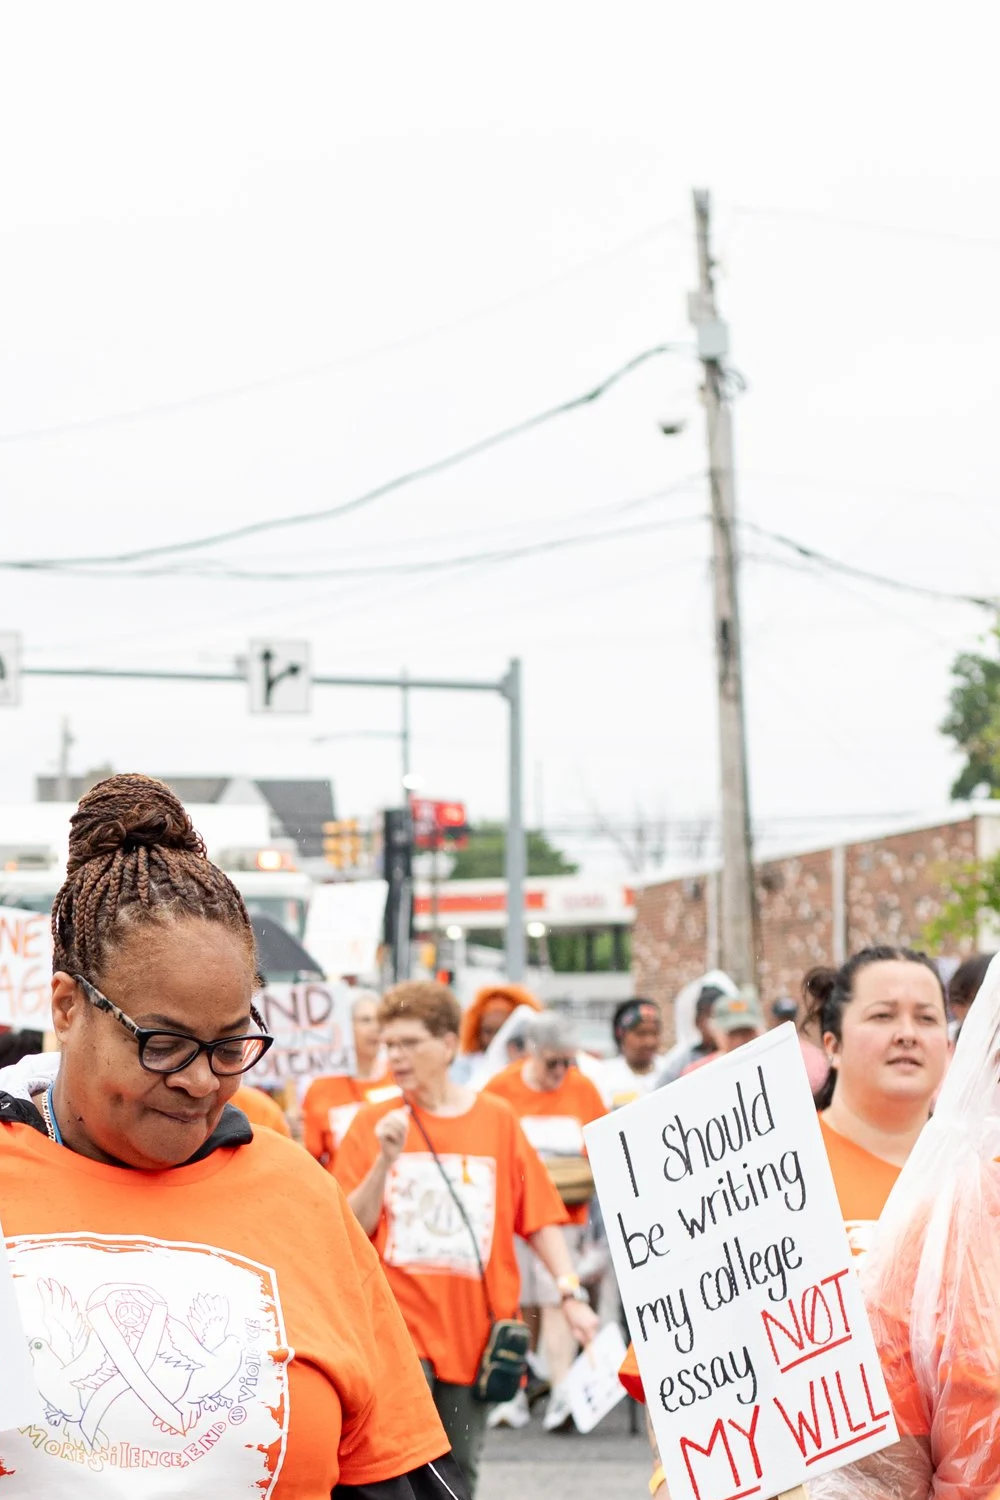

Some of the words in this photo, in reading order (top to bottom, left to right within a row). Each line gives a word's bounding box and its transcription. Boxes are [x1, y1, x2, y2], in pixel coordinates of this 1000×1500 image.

[260, 984, 334, 1028] ND
[617, 1212, 671, 1270] be
[677, 1150, 807, 1240] writing
[619, 1131, 640, 1198] I
[636, 1286, 695, 1354] my
[699, 1236, 803, 1313] college
[660, 1344, 758, 1413] essay
[760, 1268, 851, 1366] NOT
[773, 1362, 891, 1459] WILL
